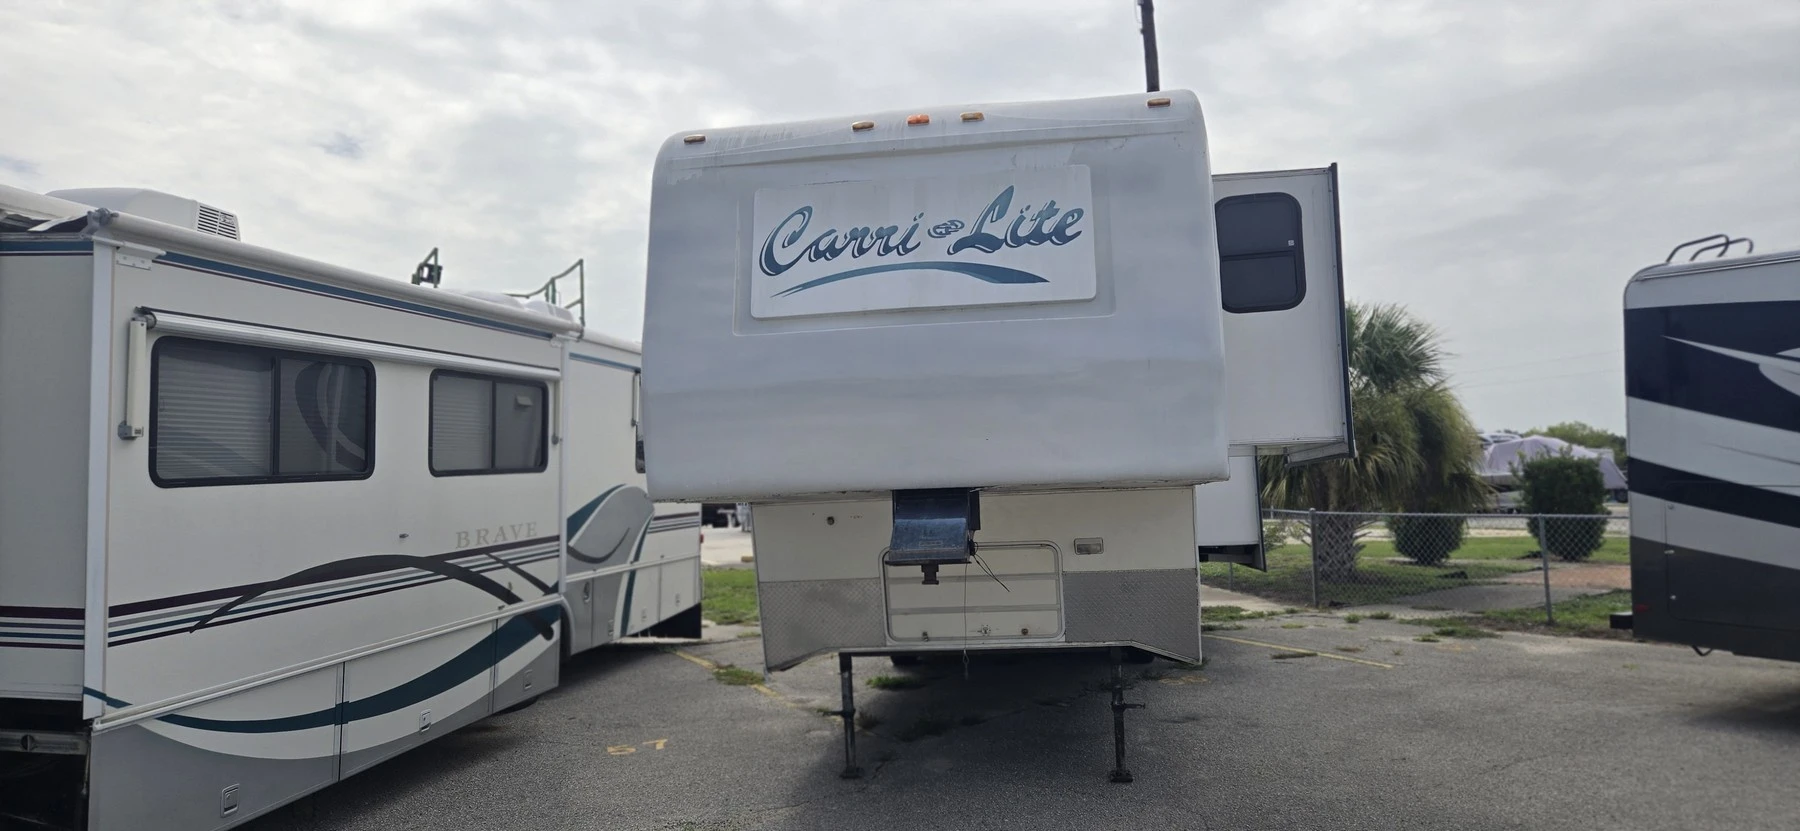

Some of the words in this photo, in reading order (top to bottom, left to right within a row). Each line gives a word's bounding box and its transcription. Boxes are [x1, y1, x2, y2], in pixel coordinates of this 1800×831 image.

[759, 205, 925, 276] Carri
[947, 184, 1084, 255] Lite
[455, 521, 538, 549] BRAVE
